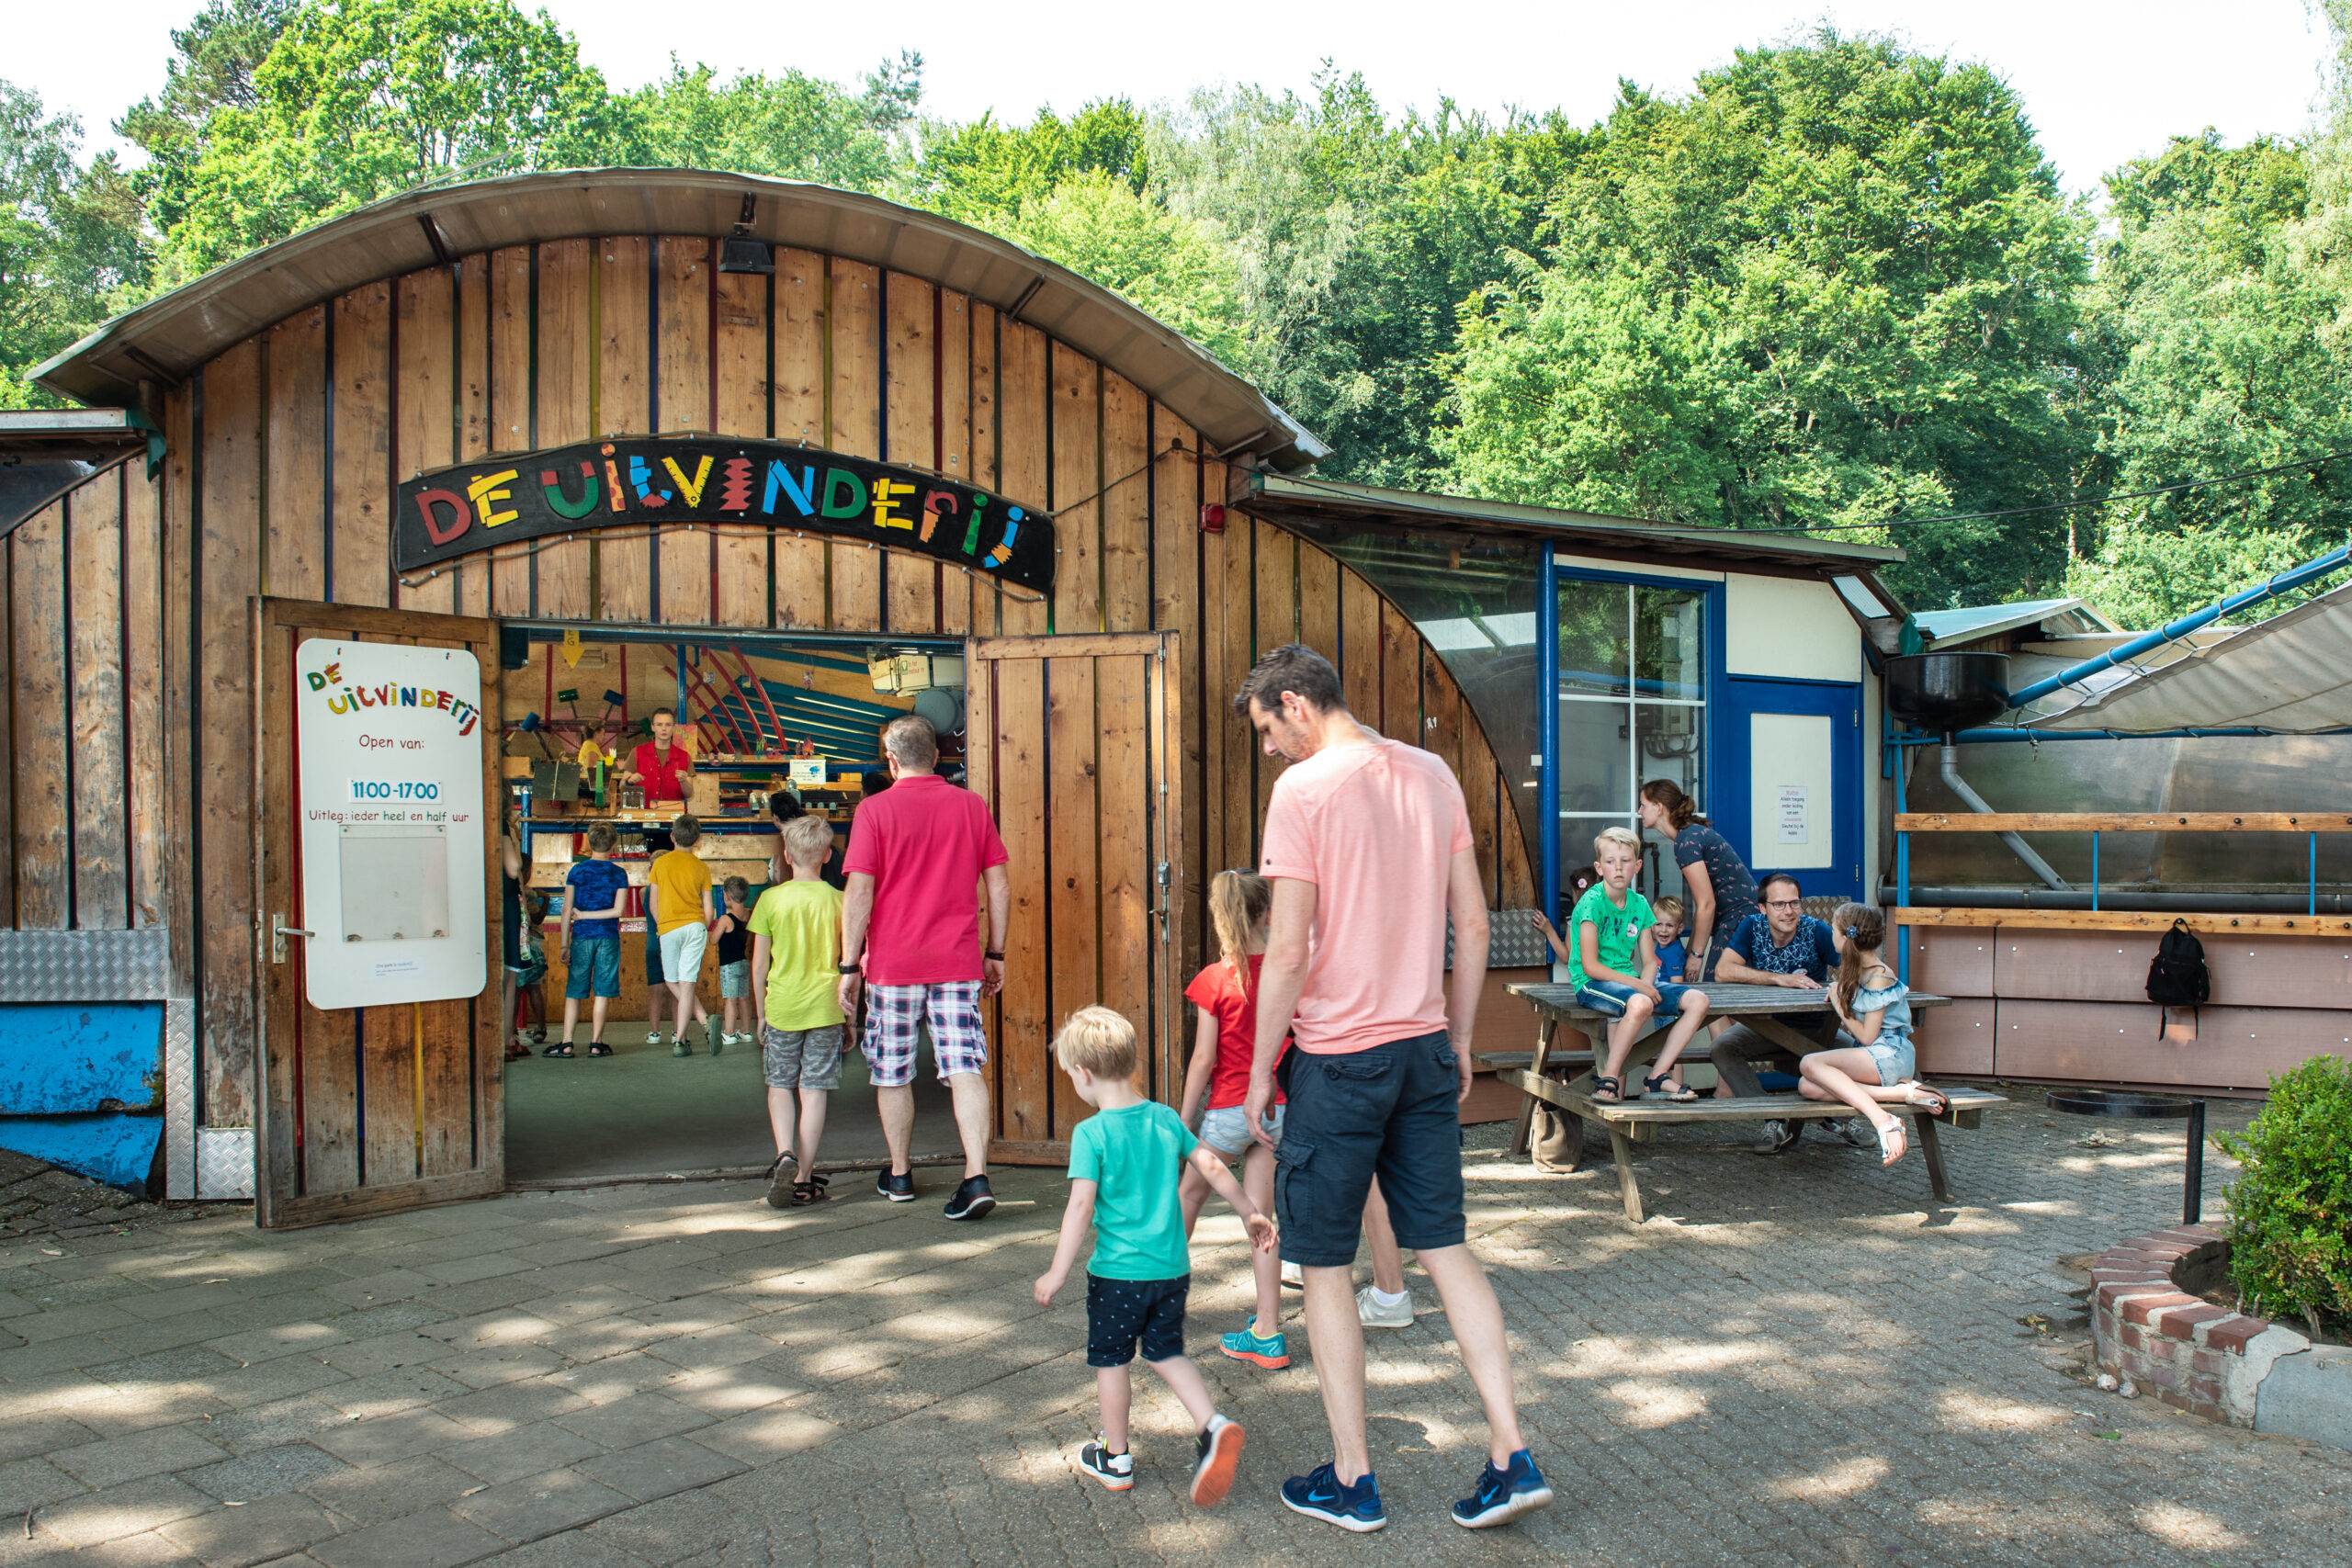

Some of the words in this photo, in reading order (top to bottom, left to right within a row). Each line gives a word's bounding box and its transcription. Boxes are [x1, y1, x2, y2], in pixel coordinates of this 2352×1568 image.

[415, 468, 519, 547] DE
[307, 662, 343, 692] DE
[358, 734, 394, 751] Open
[400, 739, 425, 750] van:
[309, 809, 349, 824] Uitleg:
[351, 810, 379, 821] ieder
[383, 810, 406, 822] heel
[411, 813, 424, 821] en
[426, 811, 447, 823] half
[452, 814, 469, 823] uur
